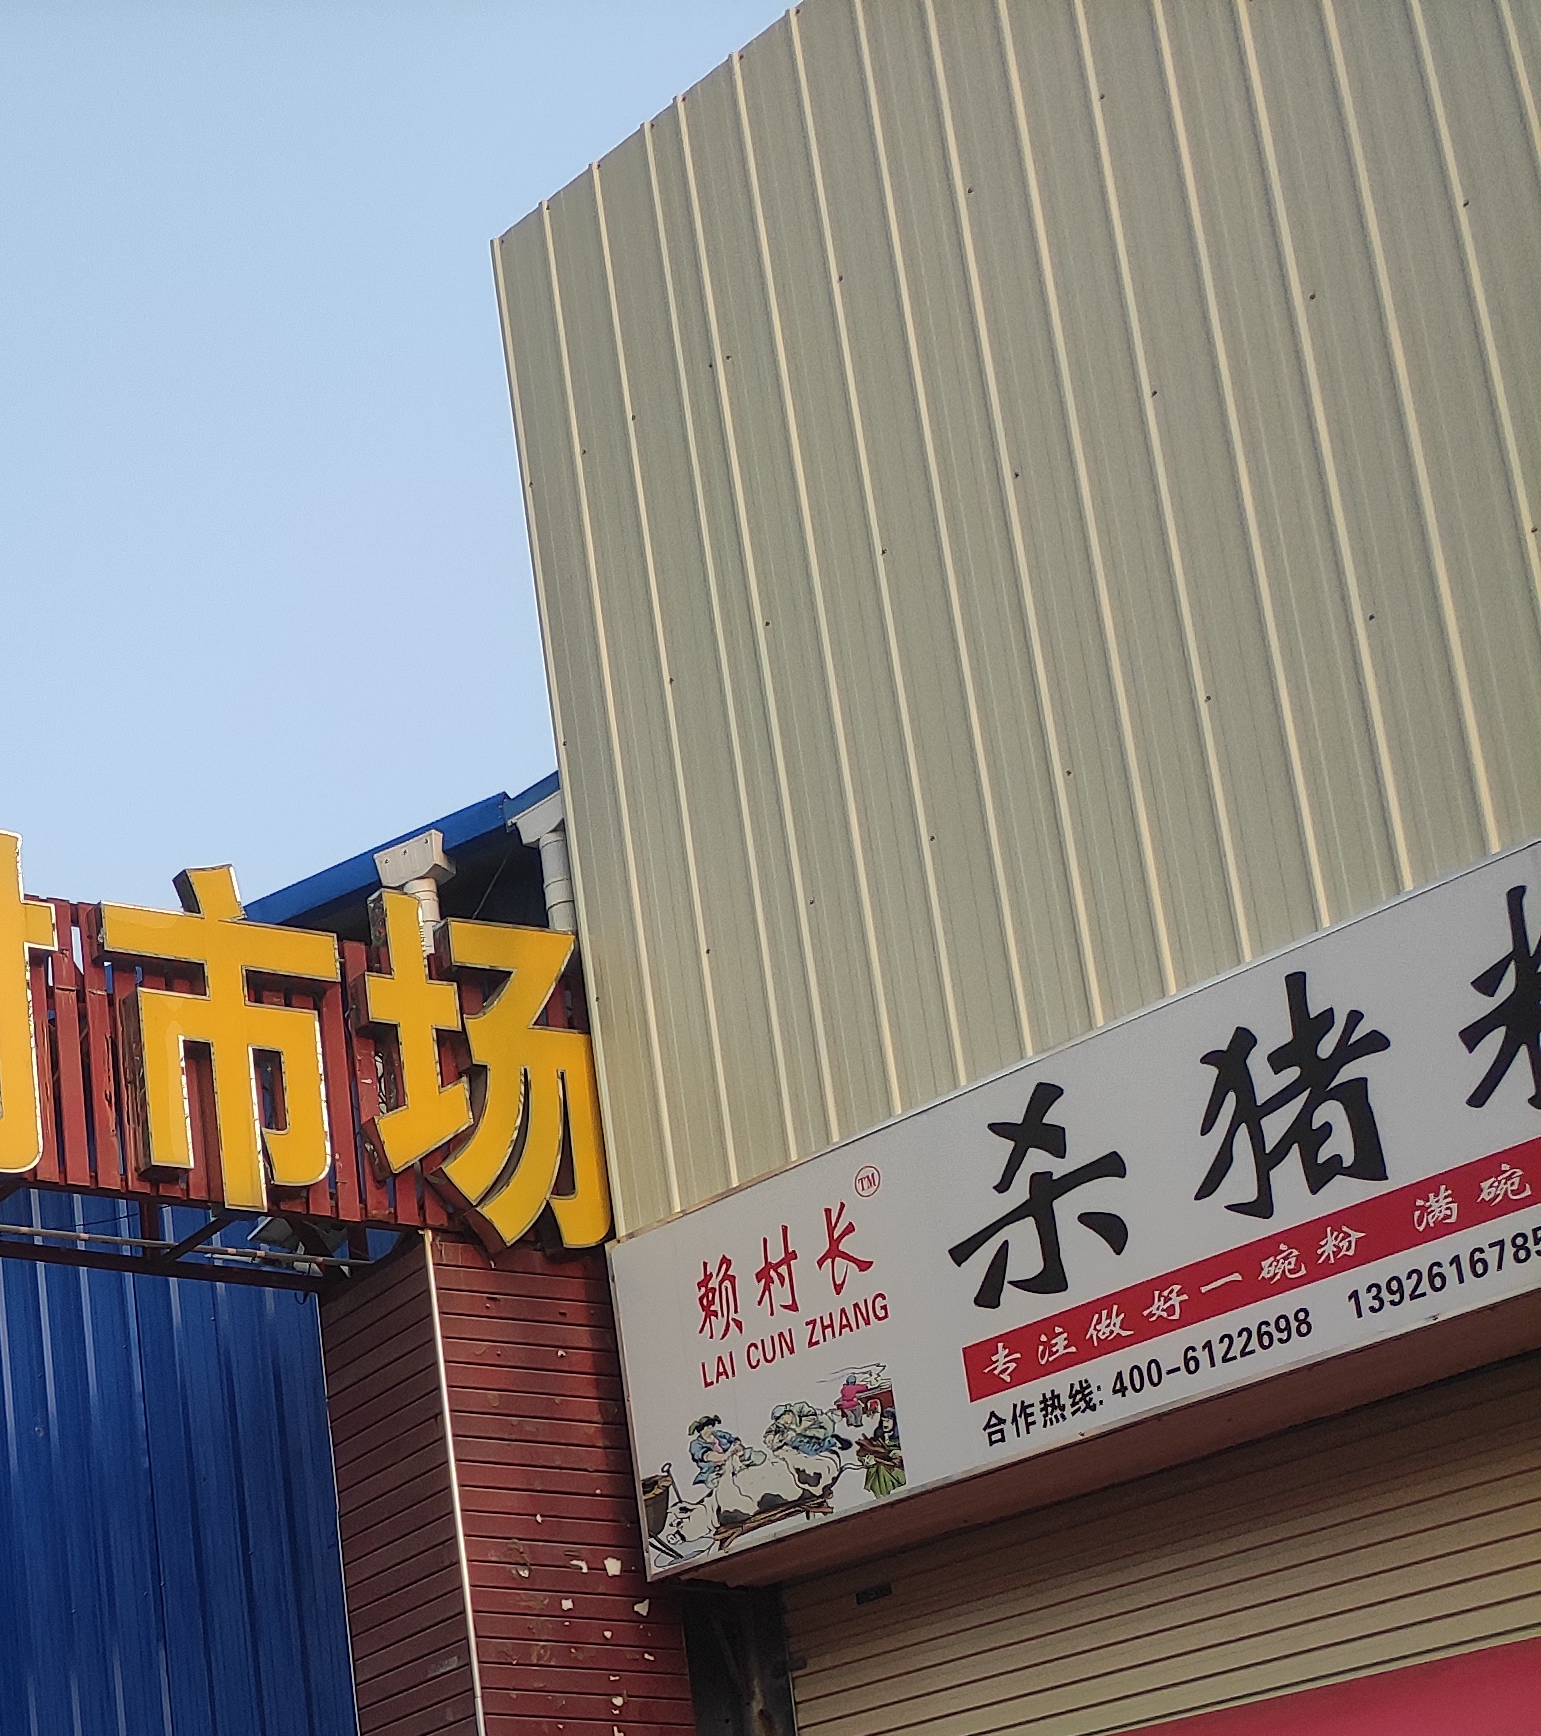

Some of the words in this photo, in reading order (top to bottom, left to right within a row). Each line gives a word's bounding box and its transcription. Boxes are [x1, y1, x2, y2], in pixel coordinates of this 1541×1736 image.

[696, 1202, 875, 1341] 赖村长
[700, 1354, 736, 1388] LAI
[746, 1326, 796, 1374] CUN
[806, 1291, 891, 1353] ZHANG
[983, 1225, 1363, 1385] 专注做好一碗粉
